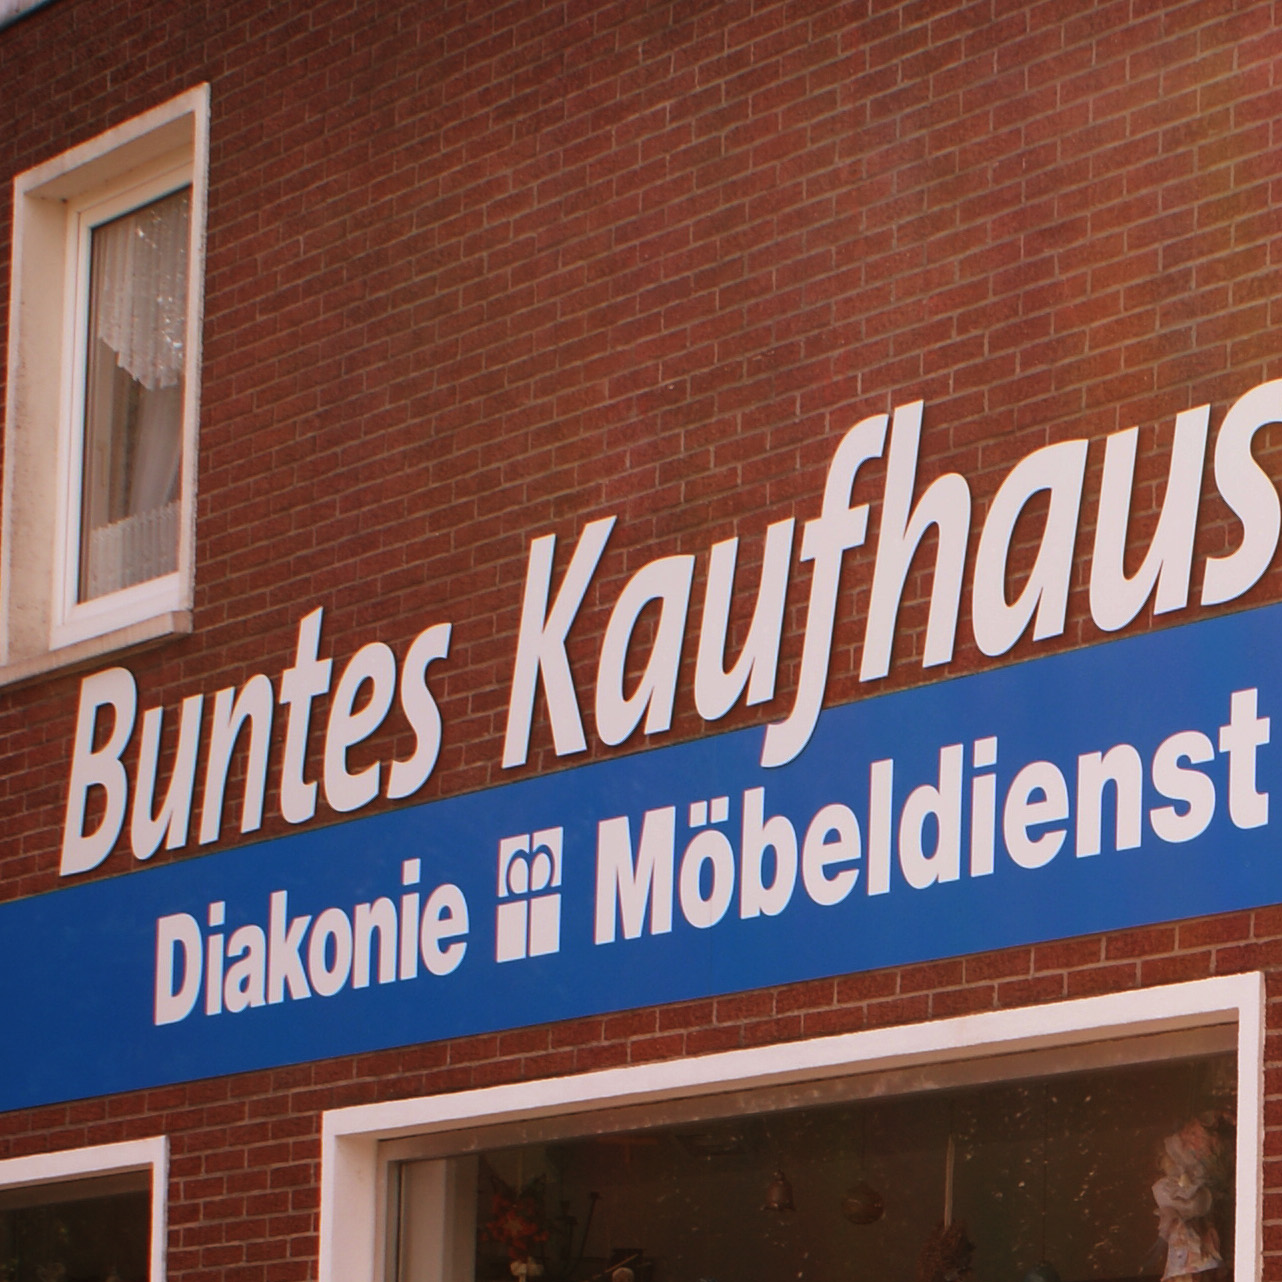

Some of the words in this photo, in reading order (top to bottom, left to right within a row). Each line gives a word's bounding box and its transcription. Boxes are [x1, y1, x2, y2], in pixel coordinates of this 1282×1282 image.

[59, 606, 453, 878] Buntes
[154, 861, 468, 1027] Diakonie
[595, 688, 1271, 946] Möbeldienst
